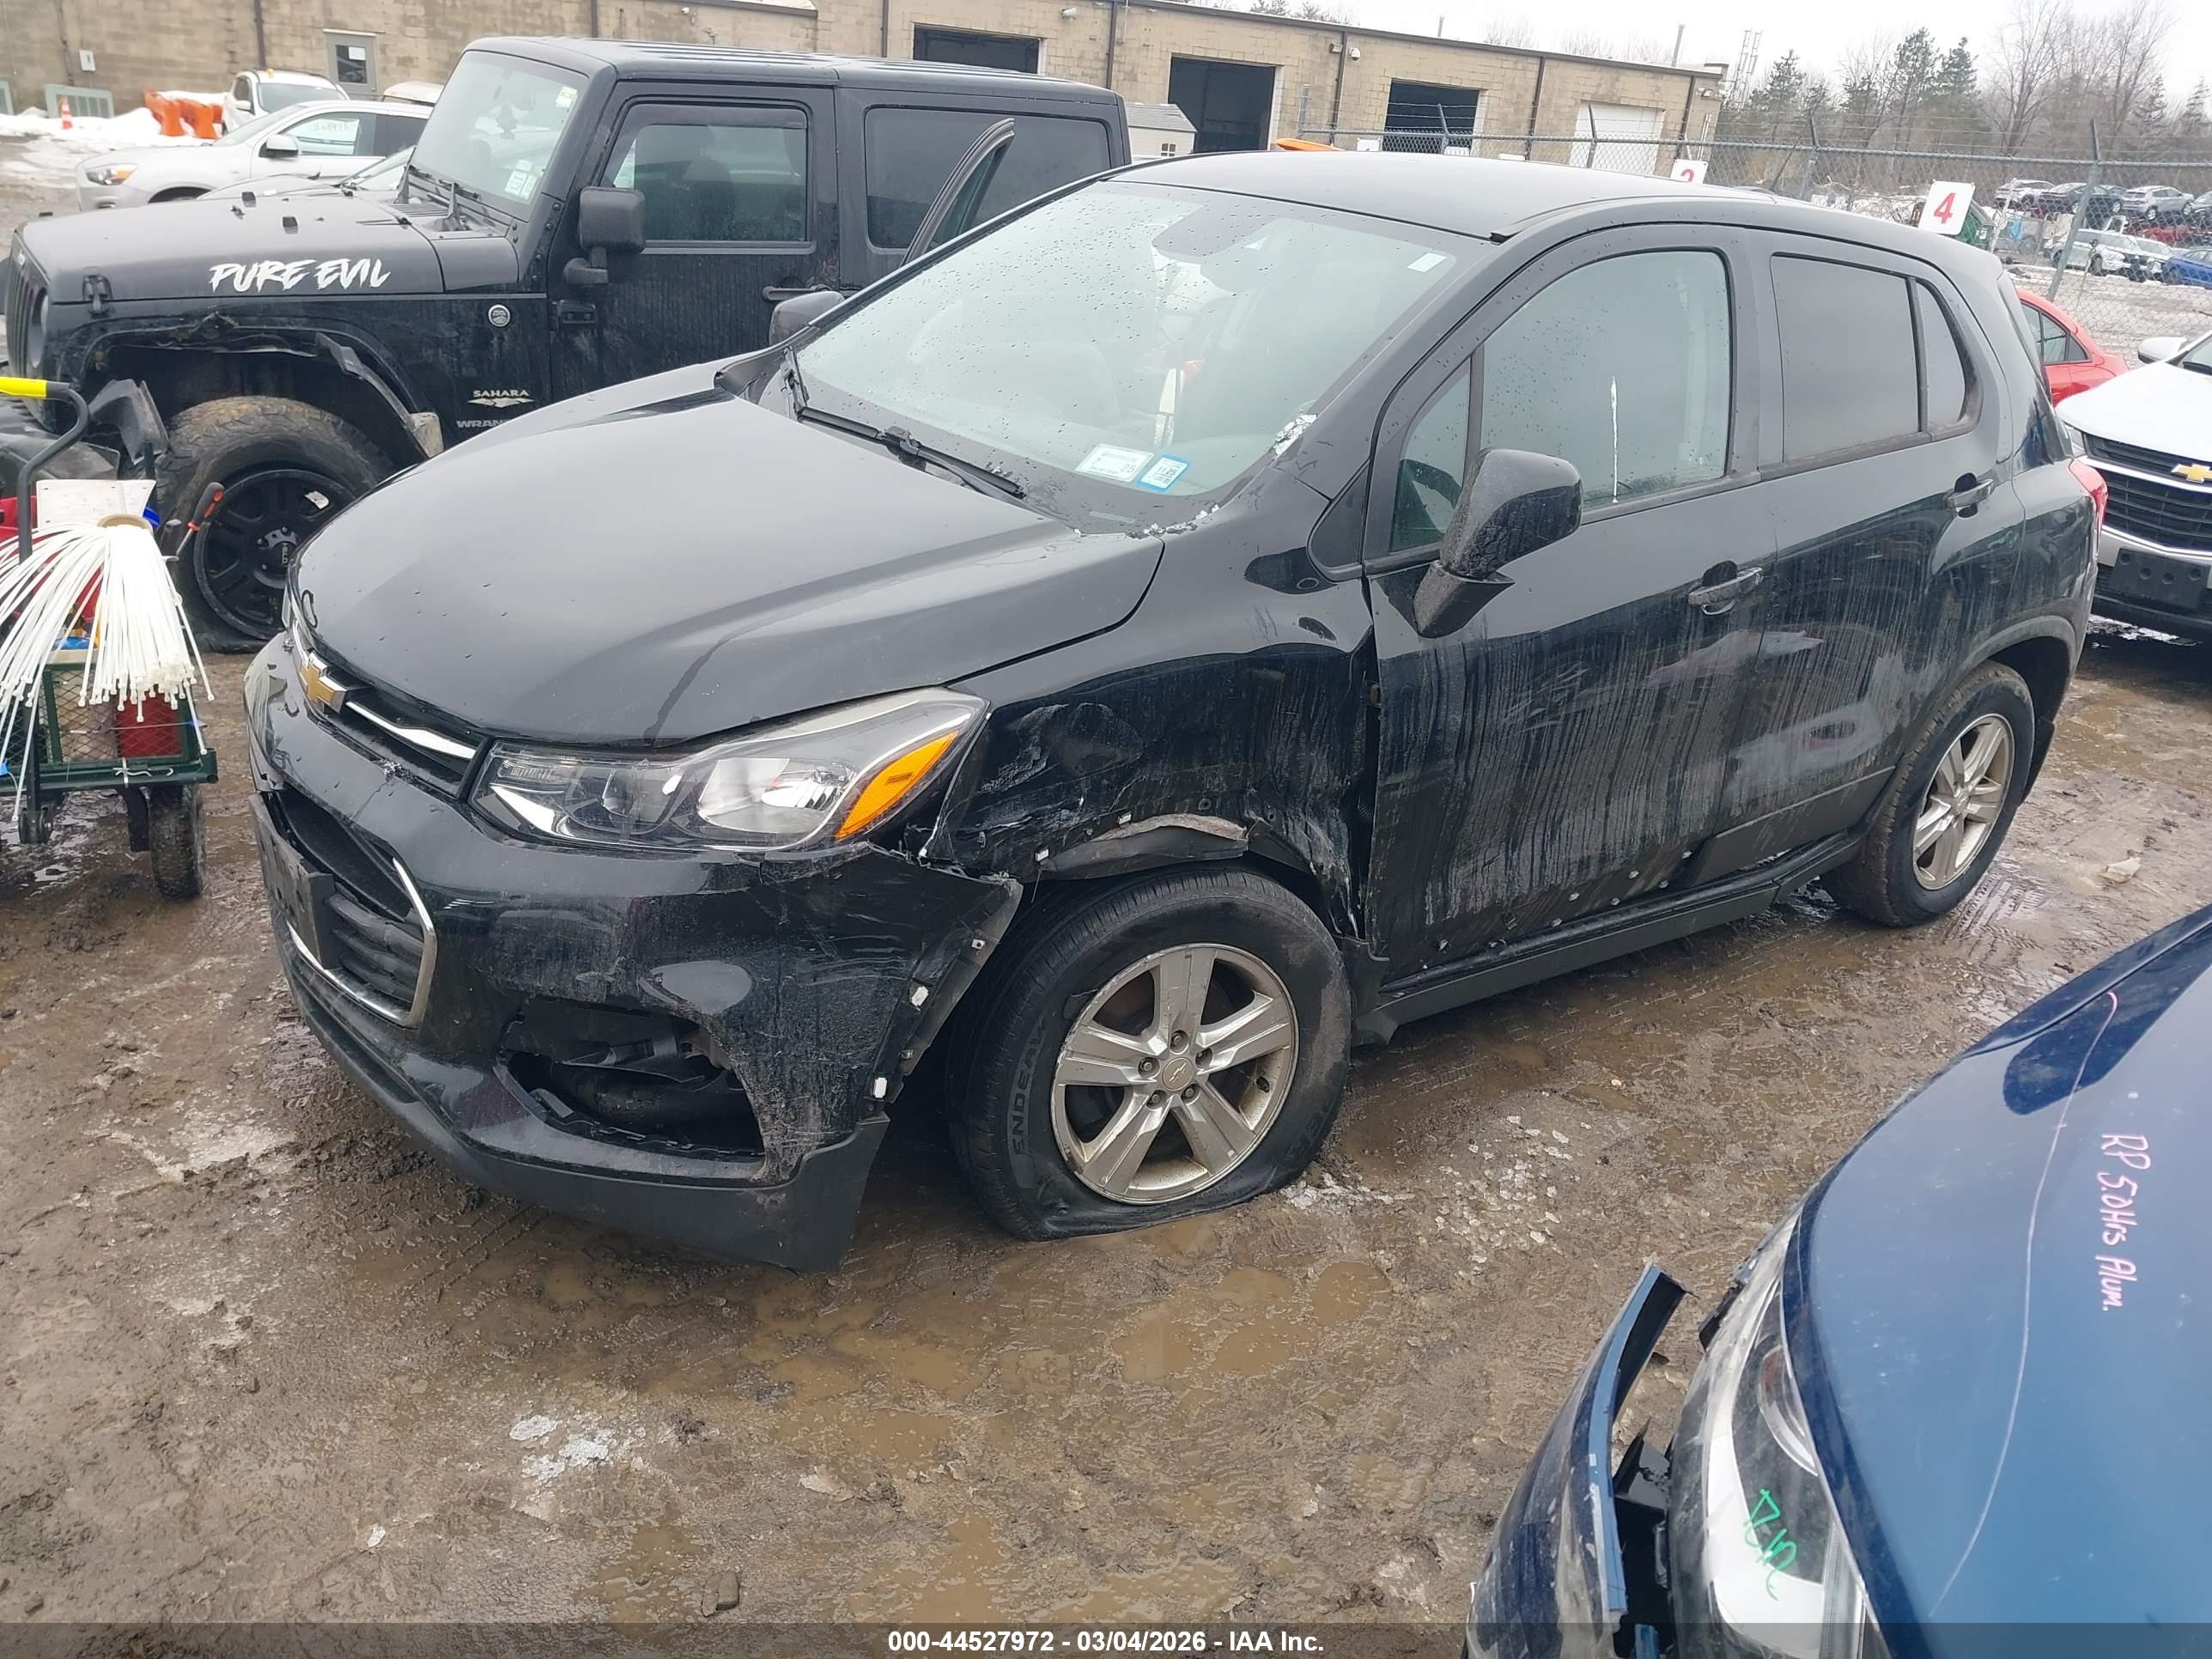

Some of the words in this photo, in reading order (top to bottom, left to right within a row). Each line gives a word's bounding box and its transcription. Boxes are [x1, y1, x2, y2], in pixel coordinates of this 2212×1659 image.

[1933, 192, 1956, 224] 4
[208, 259, 317, 293] PURE
[313, 258, 392, 290] EVIL
[473, 389, 530, 398] SAHARA
[456, 419, 511, 428] WRAN
[2101, 1133, 2152, 1170] RP
[2095, 1255, 2138, 1311] Alum.
